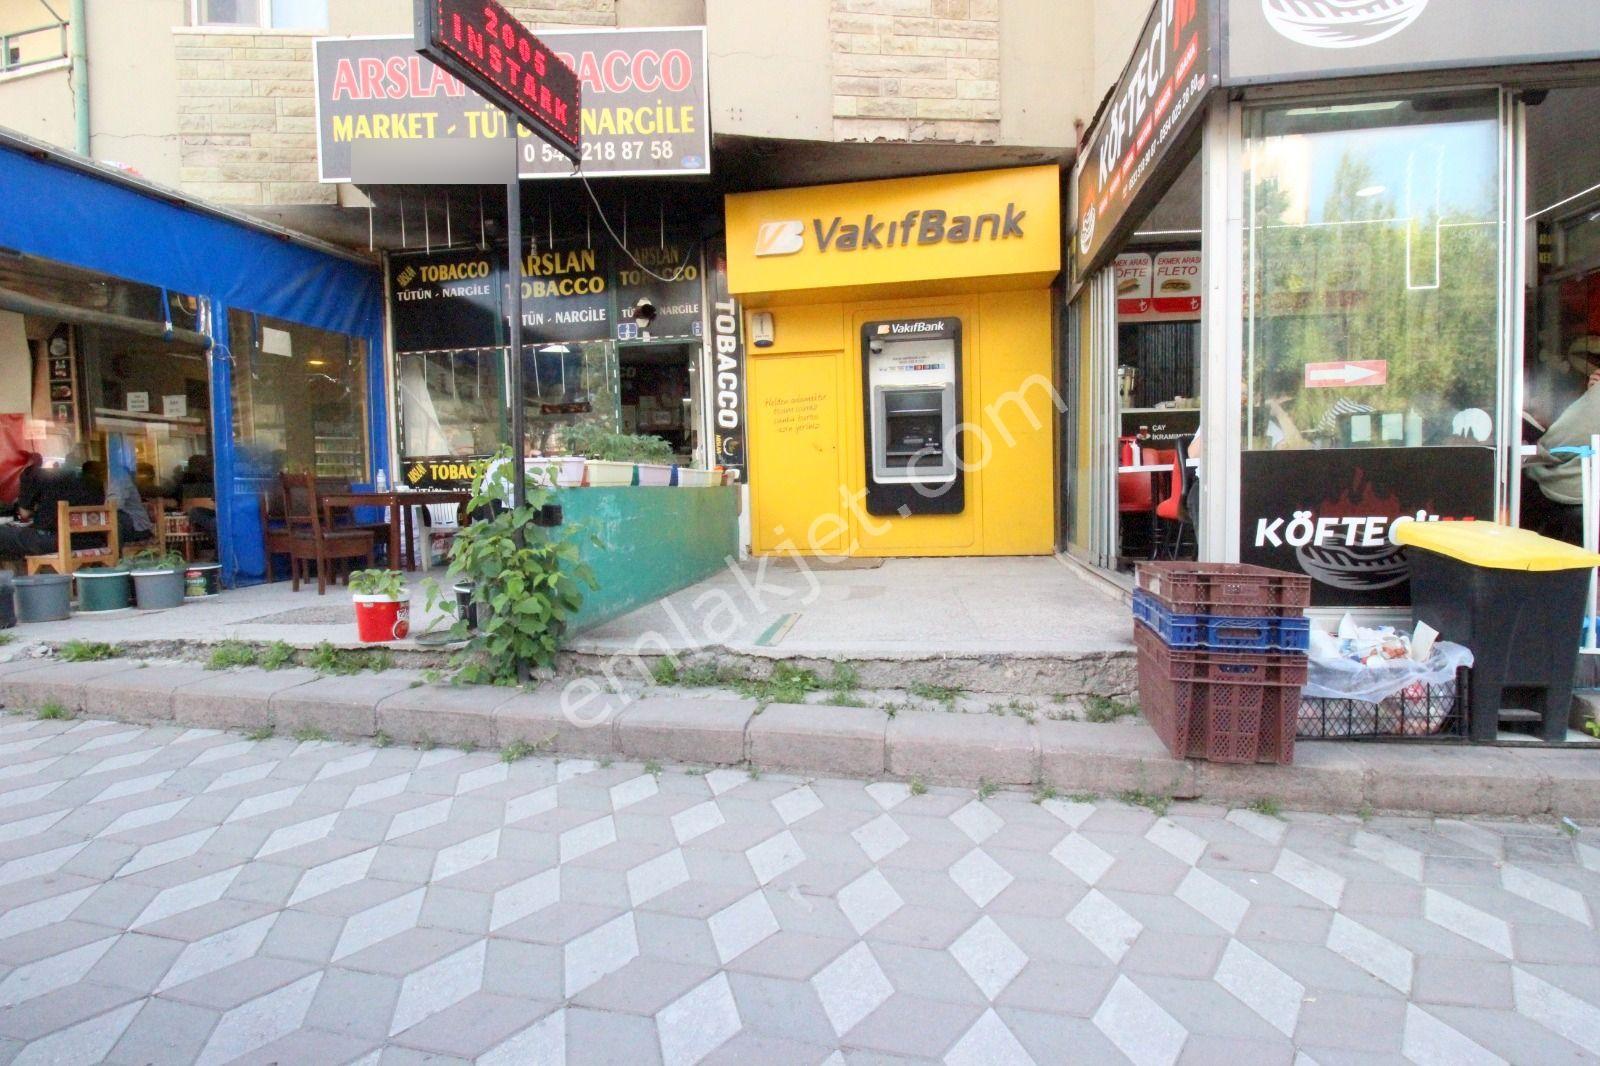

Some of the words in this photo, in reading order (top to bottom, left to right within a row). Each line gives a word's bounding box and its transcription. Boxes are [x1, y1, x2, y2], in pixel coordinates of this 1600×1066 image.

[484, 7, 546, 77] 2005
[332, 112, 438, 142] MARKET
[580, 99, 695, 135] NARGİLE
[524, 144, 535, 162] 0
[541, 142, 573, 162] 54
[582, 142, 616, 161] 218
[621, 142, 644, 160] 87
[650, 141, 673, 159] 58
[813, 203, 1027, 253] VakıfBank
[1158, 257, 1180, 265] EKMEK
[420, 261, 490, 283] TOBACCO
[396, 289, 433, 302] TÜTÜN
[442, 284, 491, 298] NARGİLE
[555, 306, 607, 325] NARGİLE
[892, 320, 945, 334] VakıfBank
[715, 298, 739, 429] TOBACCO
[1152, 424, 1166, 432] ÇAY
[430, 463, 478, 481] TOBAC
